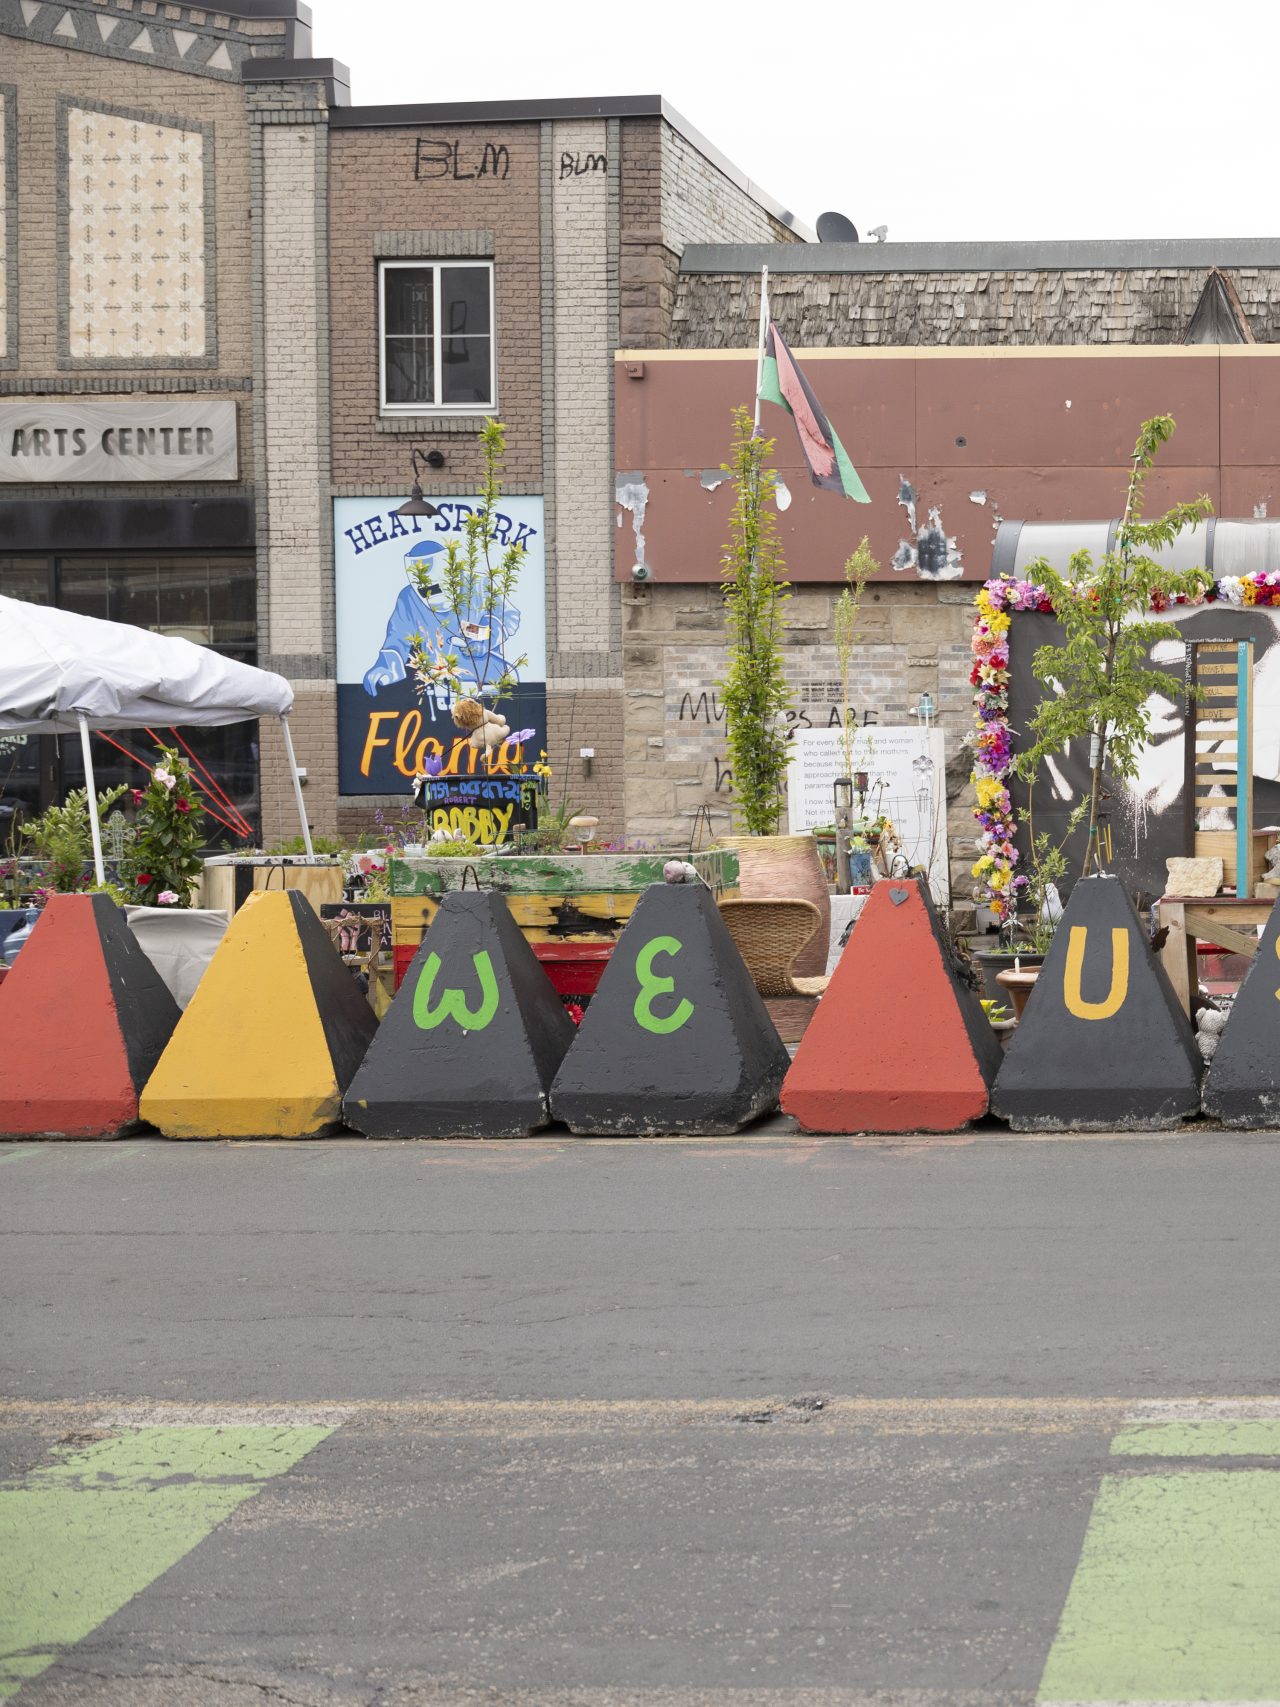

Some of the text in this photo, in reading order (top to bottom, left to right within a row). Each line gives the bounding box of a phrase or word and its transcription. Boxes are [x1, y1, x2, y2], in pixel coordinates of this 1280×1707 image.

[413, 138, 511, 181] BLM
[560, 152, 608, 180] BLM
[11, 426, 215, 457] ARTS CENTER
[1203, 709, 1223, 718] LOVE
[360, 709, 527, 777] Flame
[433, 803, 514, 845] BOBBY
